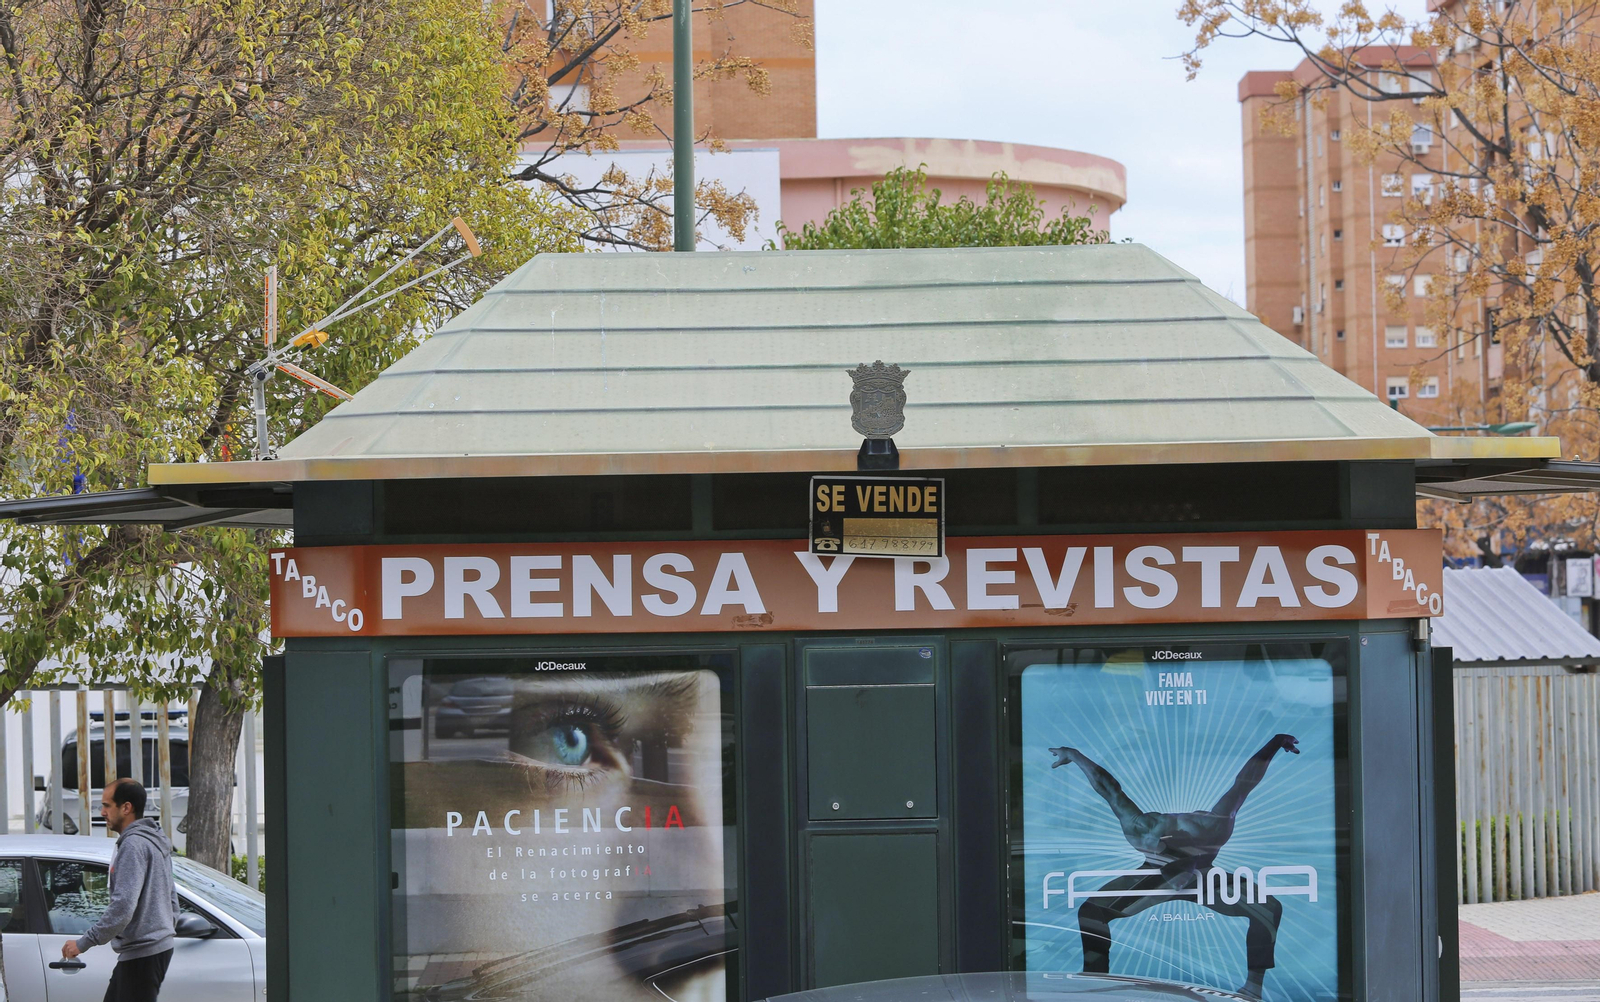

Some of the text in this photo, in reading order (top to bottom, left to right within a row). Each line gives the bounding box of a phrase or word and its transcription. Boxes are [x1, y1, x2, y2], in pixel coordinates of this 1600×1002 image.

[816, 484, 937, 513] SE VENDE
[1367, 533, 1442, 615] TABACO
[381, 545, 1359, 620] PRENSA Y REVISTAS
[271, 552, 364, 632] TABACO
[1151, 650, 1203, 660] JCDecaux
[534, 661, 587, 671] JCDecaux
[1158, 672, 1194, 688] FAMA
[1145, 689, 1207, 706] VIVE EN TI
[446, 804, 685, 837] PACIENCIA
[487, 843, 645, 858] El Renacimiento
[489, 869, 508, 880] de
[521, 869, 536, 879] la
[1043, 865, 1318, 909] FAMA
[521, 891, 612, 902] se acerca
[1149, 912, 1215, 922] A BAILAR
